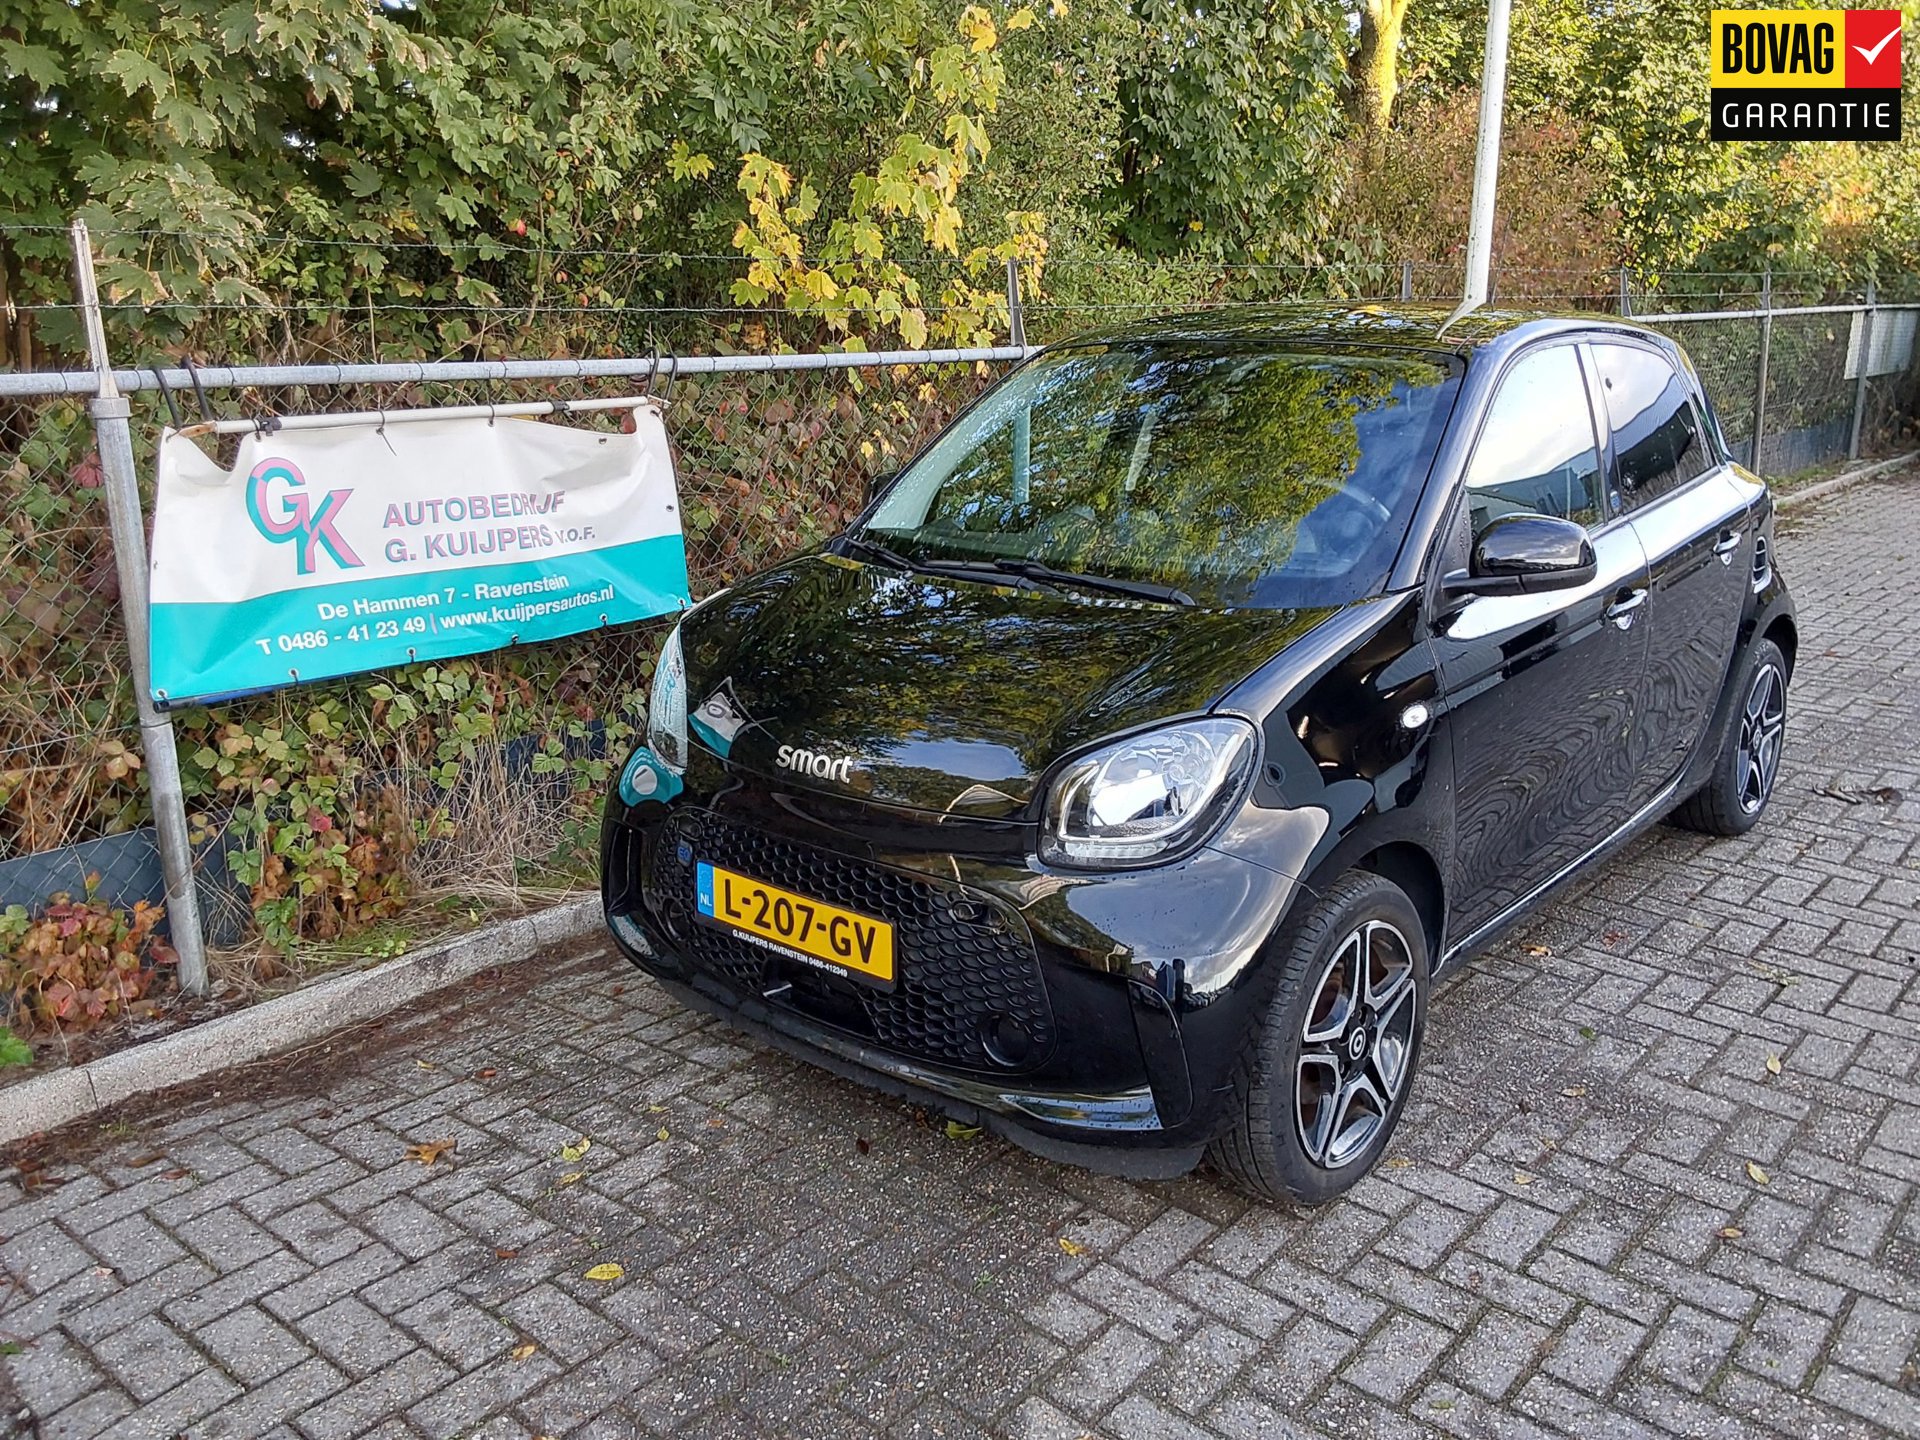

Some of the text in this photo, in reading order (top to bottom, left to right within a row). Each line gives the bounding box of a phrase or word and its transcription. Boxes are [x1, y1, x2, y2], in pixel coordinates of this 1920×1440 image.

[383, 490, 566, 528] AUTOBEDRIJF
[385, 524, 596, 563] G. KUIJPERS V.O.F.
[317, 603, 349, 620] De
[353, 593, 439, 615] Hammen
[444, 587, 456, 603] 7
[474, 574, 570, 600] Ravenstein
[256, 638, 273, 655] T
[278, 630, 329, 652] 0486
[347, 624, 370, 642] 41
[376, 621, 399, 639] 23
[403, 616, 426, 634] 49
[440, 585, 614, 629] www.kuijpersautos.nl
[775, 744, 853, 784] smart
[700, 892, 713, 907] NL
[724, 878, 876, 964] L-207-GV
[768, 942, 808, 964] RAVENSTEIN
